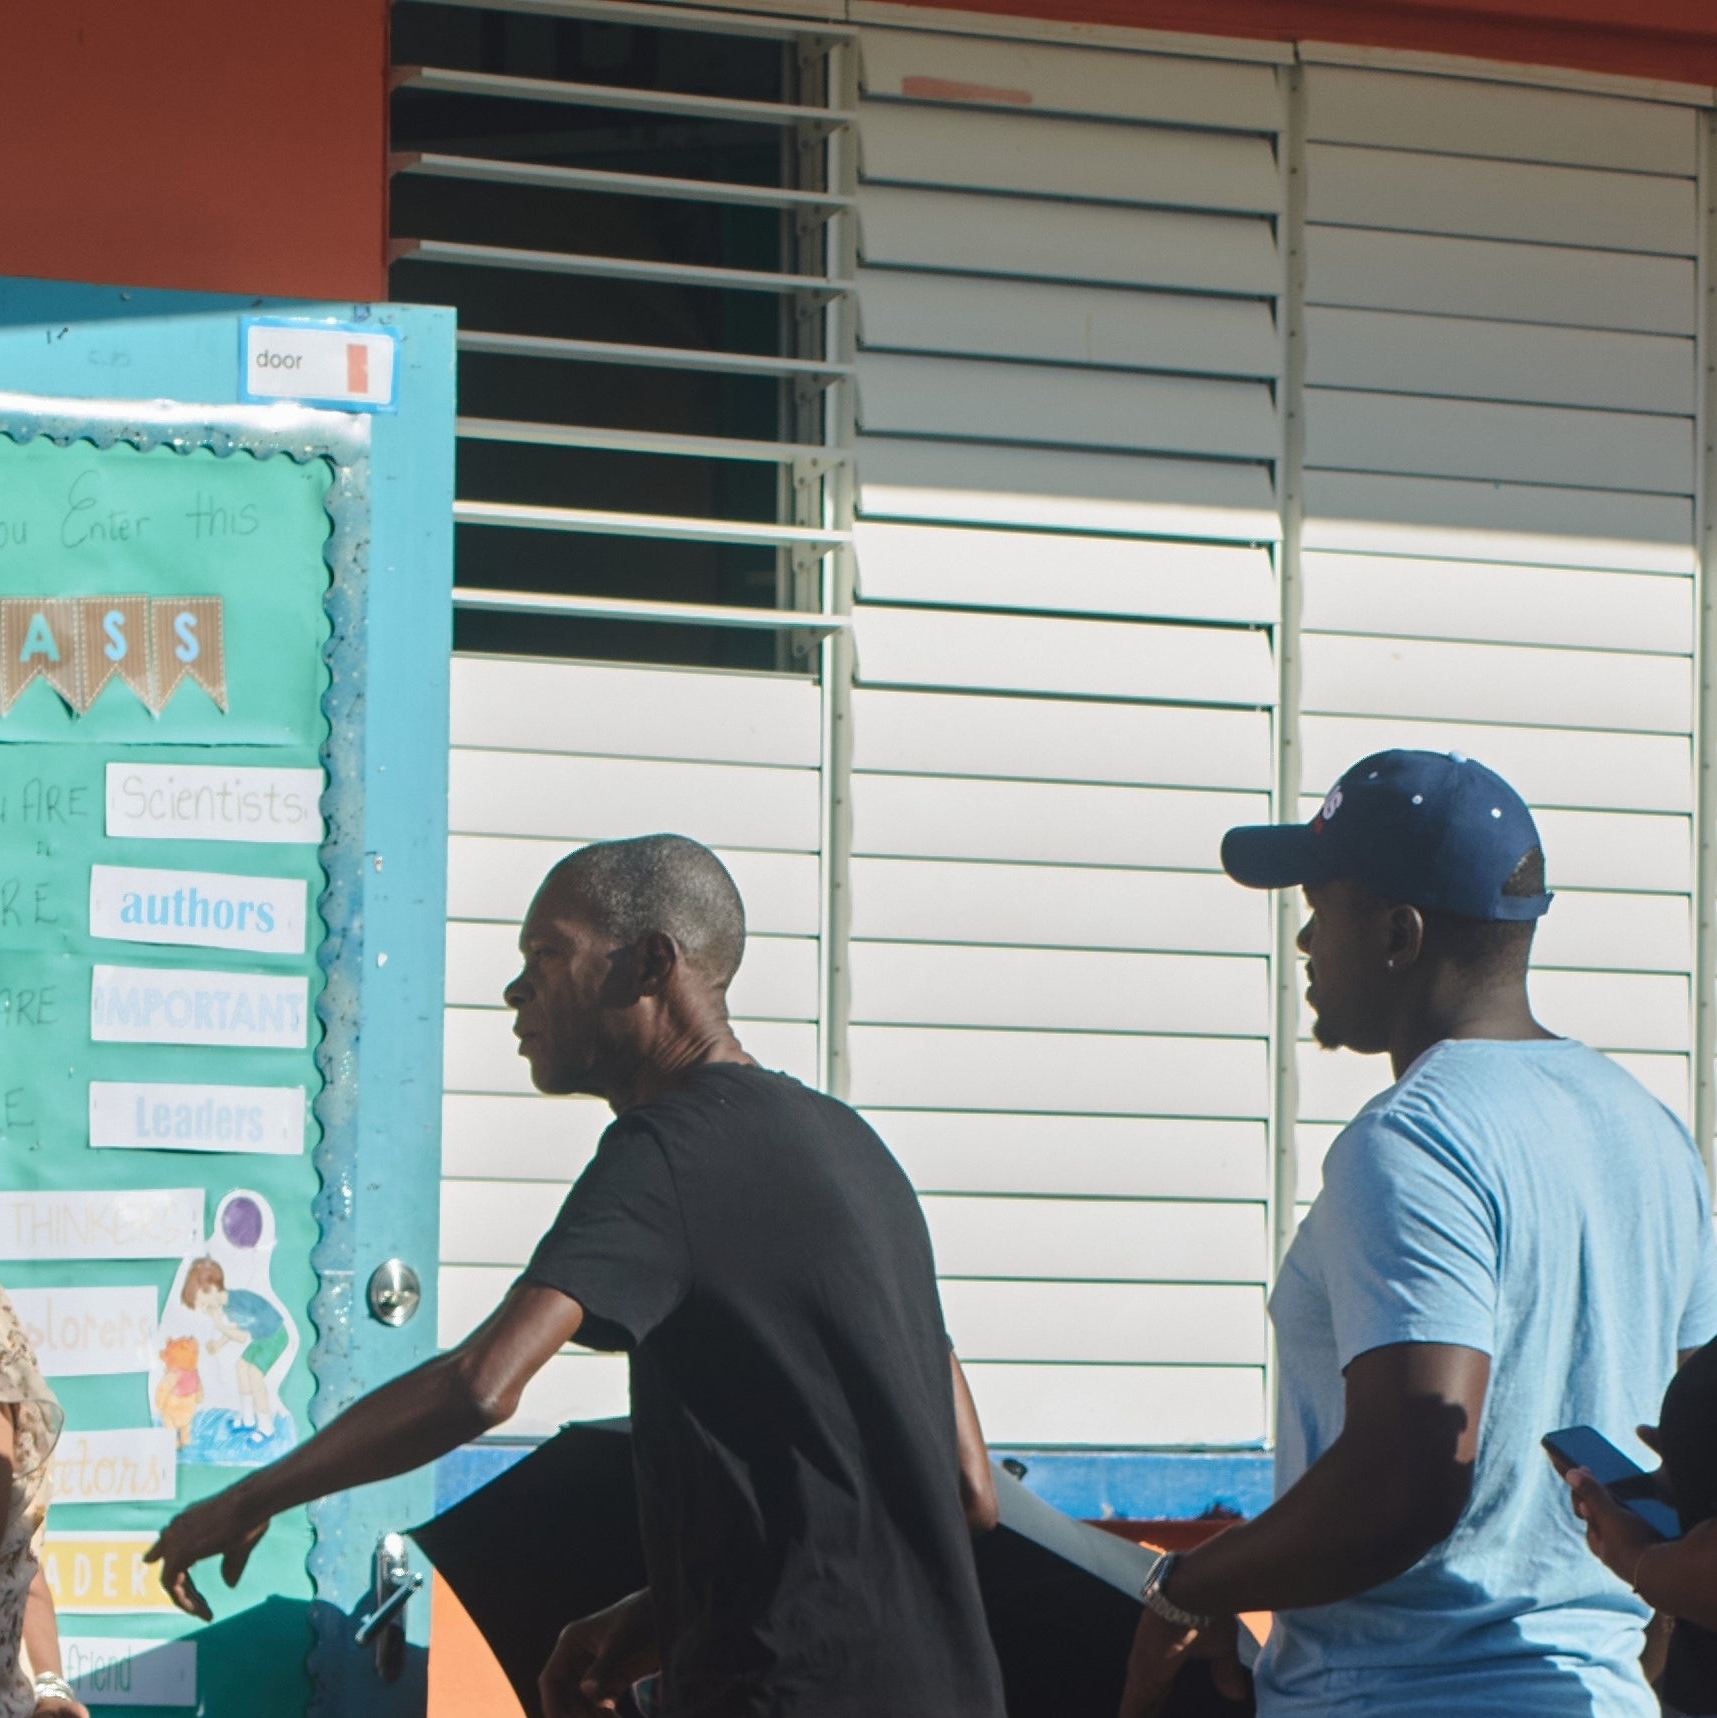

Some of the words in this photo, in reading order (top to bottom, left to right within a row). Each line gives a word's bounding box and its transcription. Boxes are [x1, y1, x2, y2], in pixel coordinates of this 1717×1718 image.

[256, 348, 303, 370] door
[61, 469, 151, 549] Enter
[185, 490, 261, 539] this
[21, 776, 89, 824] ARE
[121, 775, 304, 824] Scientists
[120, 887, 275, 935] authors
[94, 984, 304, 1033] IMPORTANT
[135, 1094, 264, 1142] Leaders
[65, 1642, 132, 1694] friend
